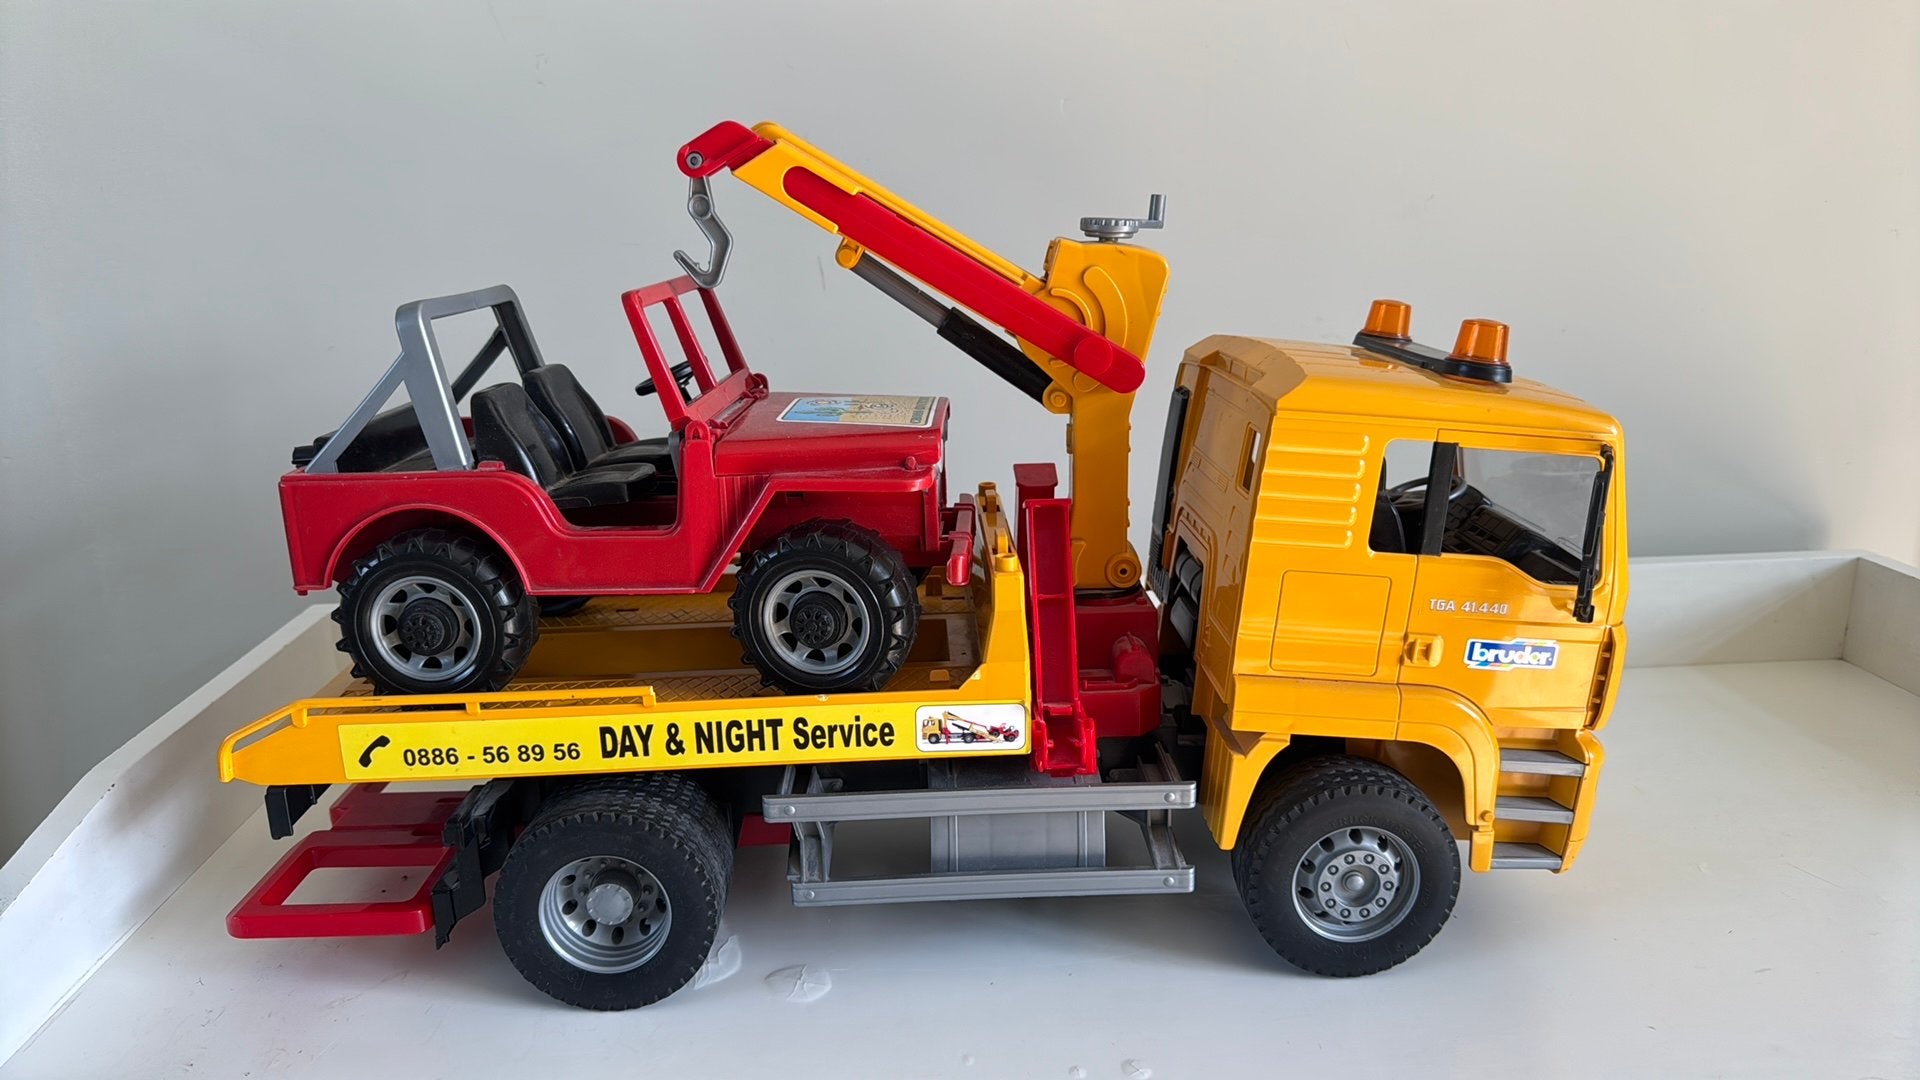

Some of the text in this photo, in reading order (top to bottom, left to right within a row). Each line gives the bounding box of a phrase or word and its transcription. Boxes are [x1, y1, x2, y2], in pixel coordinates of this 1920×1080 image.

[1430, 598, 1509, 615] TGA 41.440
[1471, 642, 1550, 666] bruder
[599, 715, 895, 759] DAY & NIGHT Service
[403, 747, 459, 767] 0886
[482, 745, 510, 764] 56
[517, 743, 545, 762] 89
[553, 742, 581, 761] 56
